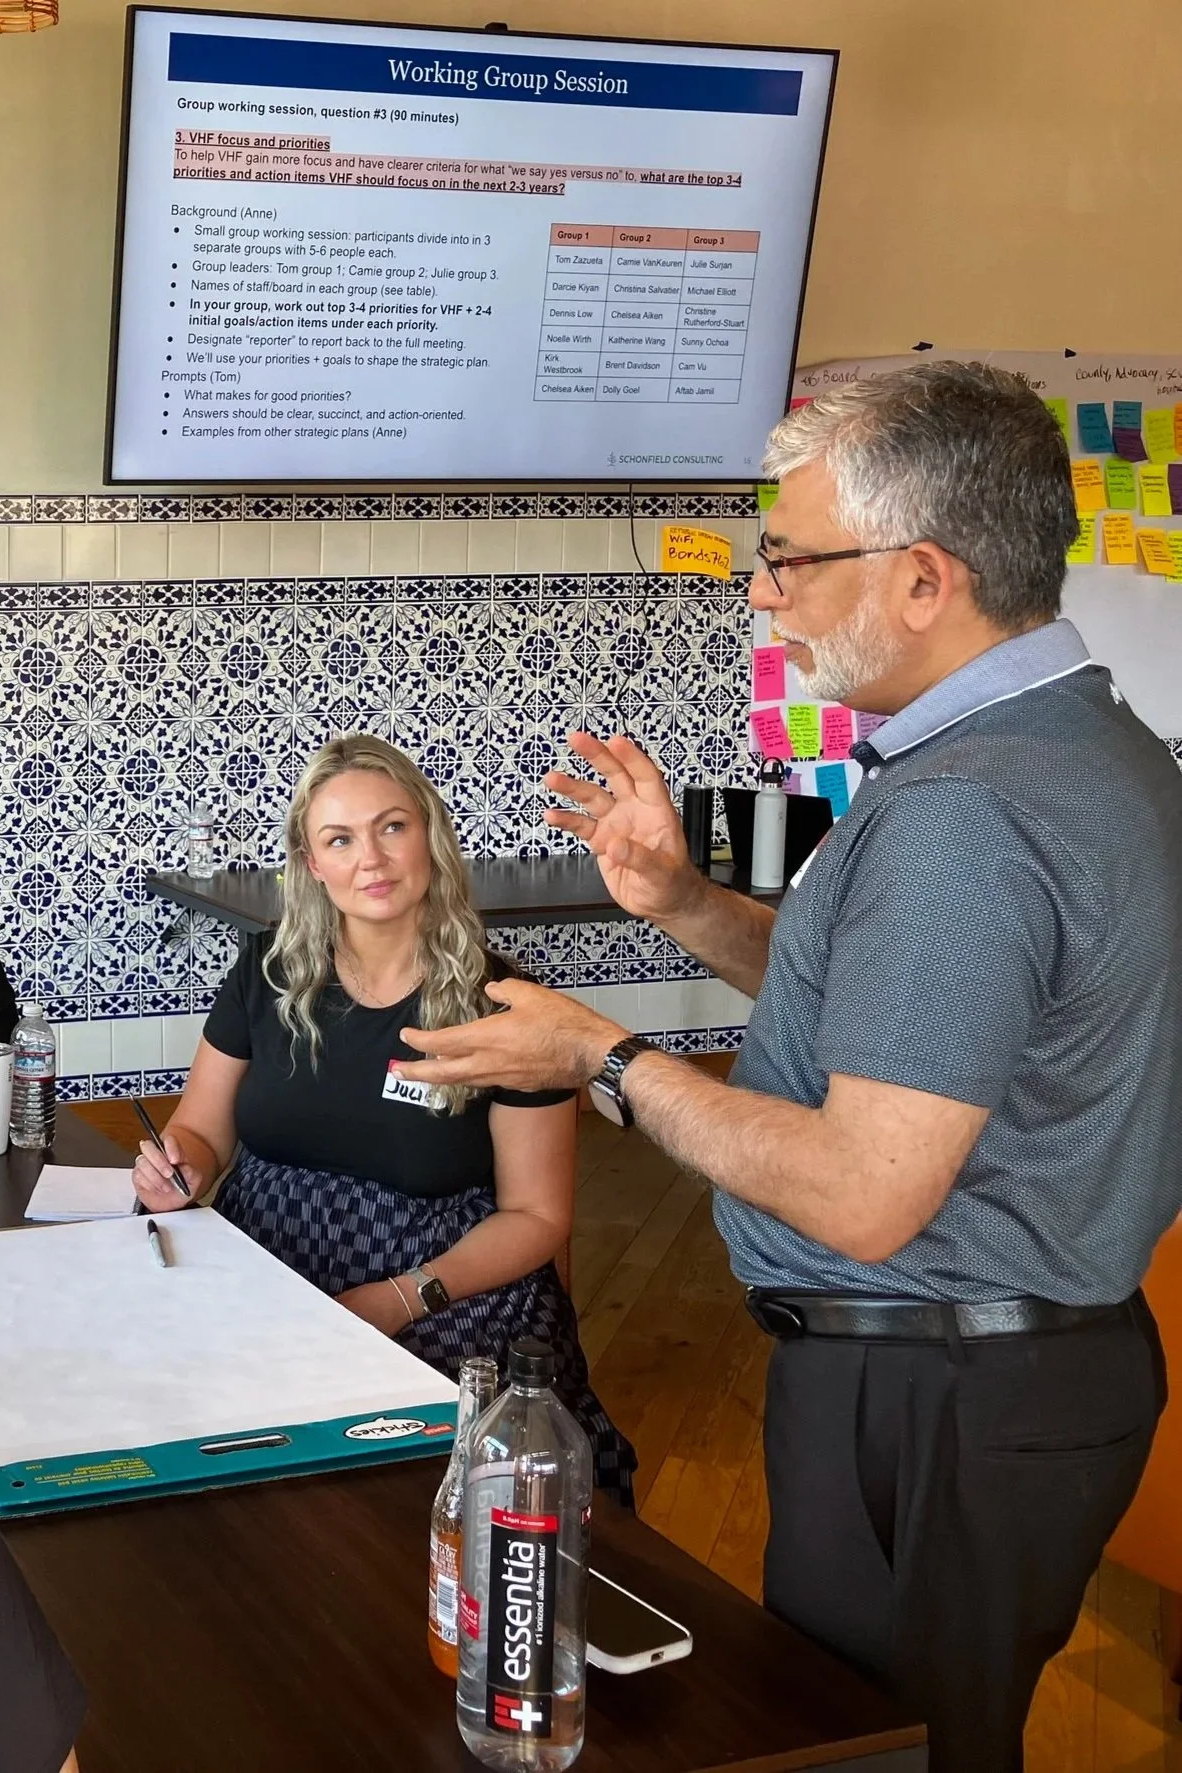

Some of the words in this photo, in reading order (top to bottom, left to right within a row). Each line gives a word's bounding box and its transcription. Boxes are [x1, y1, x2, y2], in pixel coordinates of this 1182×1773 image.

[388, 59, 478, 90] Working
[484, 65, 548, 94] Group
[553, 70, 628, 93] Session
[177, 97, 215, 112] Group
[217, 101, 265, 116] working
[268, 104, 317, 117] session,
[320, 107, 370, 119] question
[373, 108, 387, 120] #3
[390, 109, 407, 123] (90
[410, 111, 459, 126] minutes)
[174, 131, 185, 143] 3.
[188, 131, 215, 144] VHF
[217, 133, 250, 146] focus
[253, 136, 276, 147] and
[278, 137, 330, 150] priorities
[174, 147, 188, 160] To
[190, 149, 215, 163] help
[217, 150, 243, 162] VHF
[245, 152, 269, 166] gain
[272, 155, 300, 165] more
[303, 154, 332, 166] focus
[334, 156, 356, 168] and
[358, 157, 384, 169] have
[386, 159, 424, 171] clearer
[425, 161, 461, 172] criteria
[464, 162, 478, 173] for
[480, 163, 505, 175] what
[528, 167, 547, 179] say
[549, 169, 567, 179] yes
[570, 170, 603, 179] versus
[624, 170, 637, 183] to,
[638, 171, 666, 182] what
[667, 174, 685, 183] are
[687, 173, 704, 184] the
[706, 174, 724, 185] top
[725, 174, 742, 186] 3-4
[172, 166, 226, 178] priorities
[229, 168, 252, 180] and
[254, 169, 291, 181] action
[294, 170, 326, 183] items
[328, 172, 353, 184] VHF
[355, 174, 395, 186] should
[397, 175, 428, 187] focus
[431, 179, 446, 188] on
[449, 177, 460, 189] in
[462, 178, 480, 190] the
[482, 181, 507, 191] next
[509, 180, 526, 192] 2-3
[528, 182, 565, 194] years?
[170, 204, 237, 219] Background
[240, 207, 277, 221] (Anne)
[557, 230, 583, 241] Group
[584, 231, 589, 239] 1
[619, 233, 644, 243] Group
[645, 233, 652, 242] 2
[693, 235, 718, 246] Group
[719, 236, 724, 245] 3
[190, 298, 200, 309] In
[203, 301, 231, 312] your
[233, 301, 271, 313] group,
[274, 301, 302, 311] work
[305, 302, 324, 312] out
[327, 302, 346, 315] top
[348, 302, 366, 313] 3-4
[368, 303, 418, 315] priorities
[421, 303, 438, 315] for
[440, 304, 463, 315] VHF
[474, 305, 492, 316] 2-4
[188, 314, 221, 326] initial
[223, 316, 294, 328] goals/action
[297, 316, 328, 328] items
[331, 317, 364, 328] under
[366, 318, 393, 329] each
[396, 319, 438, 332] priority.
[184, 389, 212, 400] What
[215, 389, 251, 400] makes
[254, 389, 269, 401] for
[270, 390, 298, 403] good
[300, 390, 352, 403] priorities?
[618, 454, 671, 464] SCHONFIELD
[672, 455, 723, 464] CONSULTING
[501, 1539, 535, 1681] essentia
